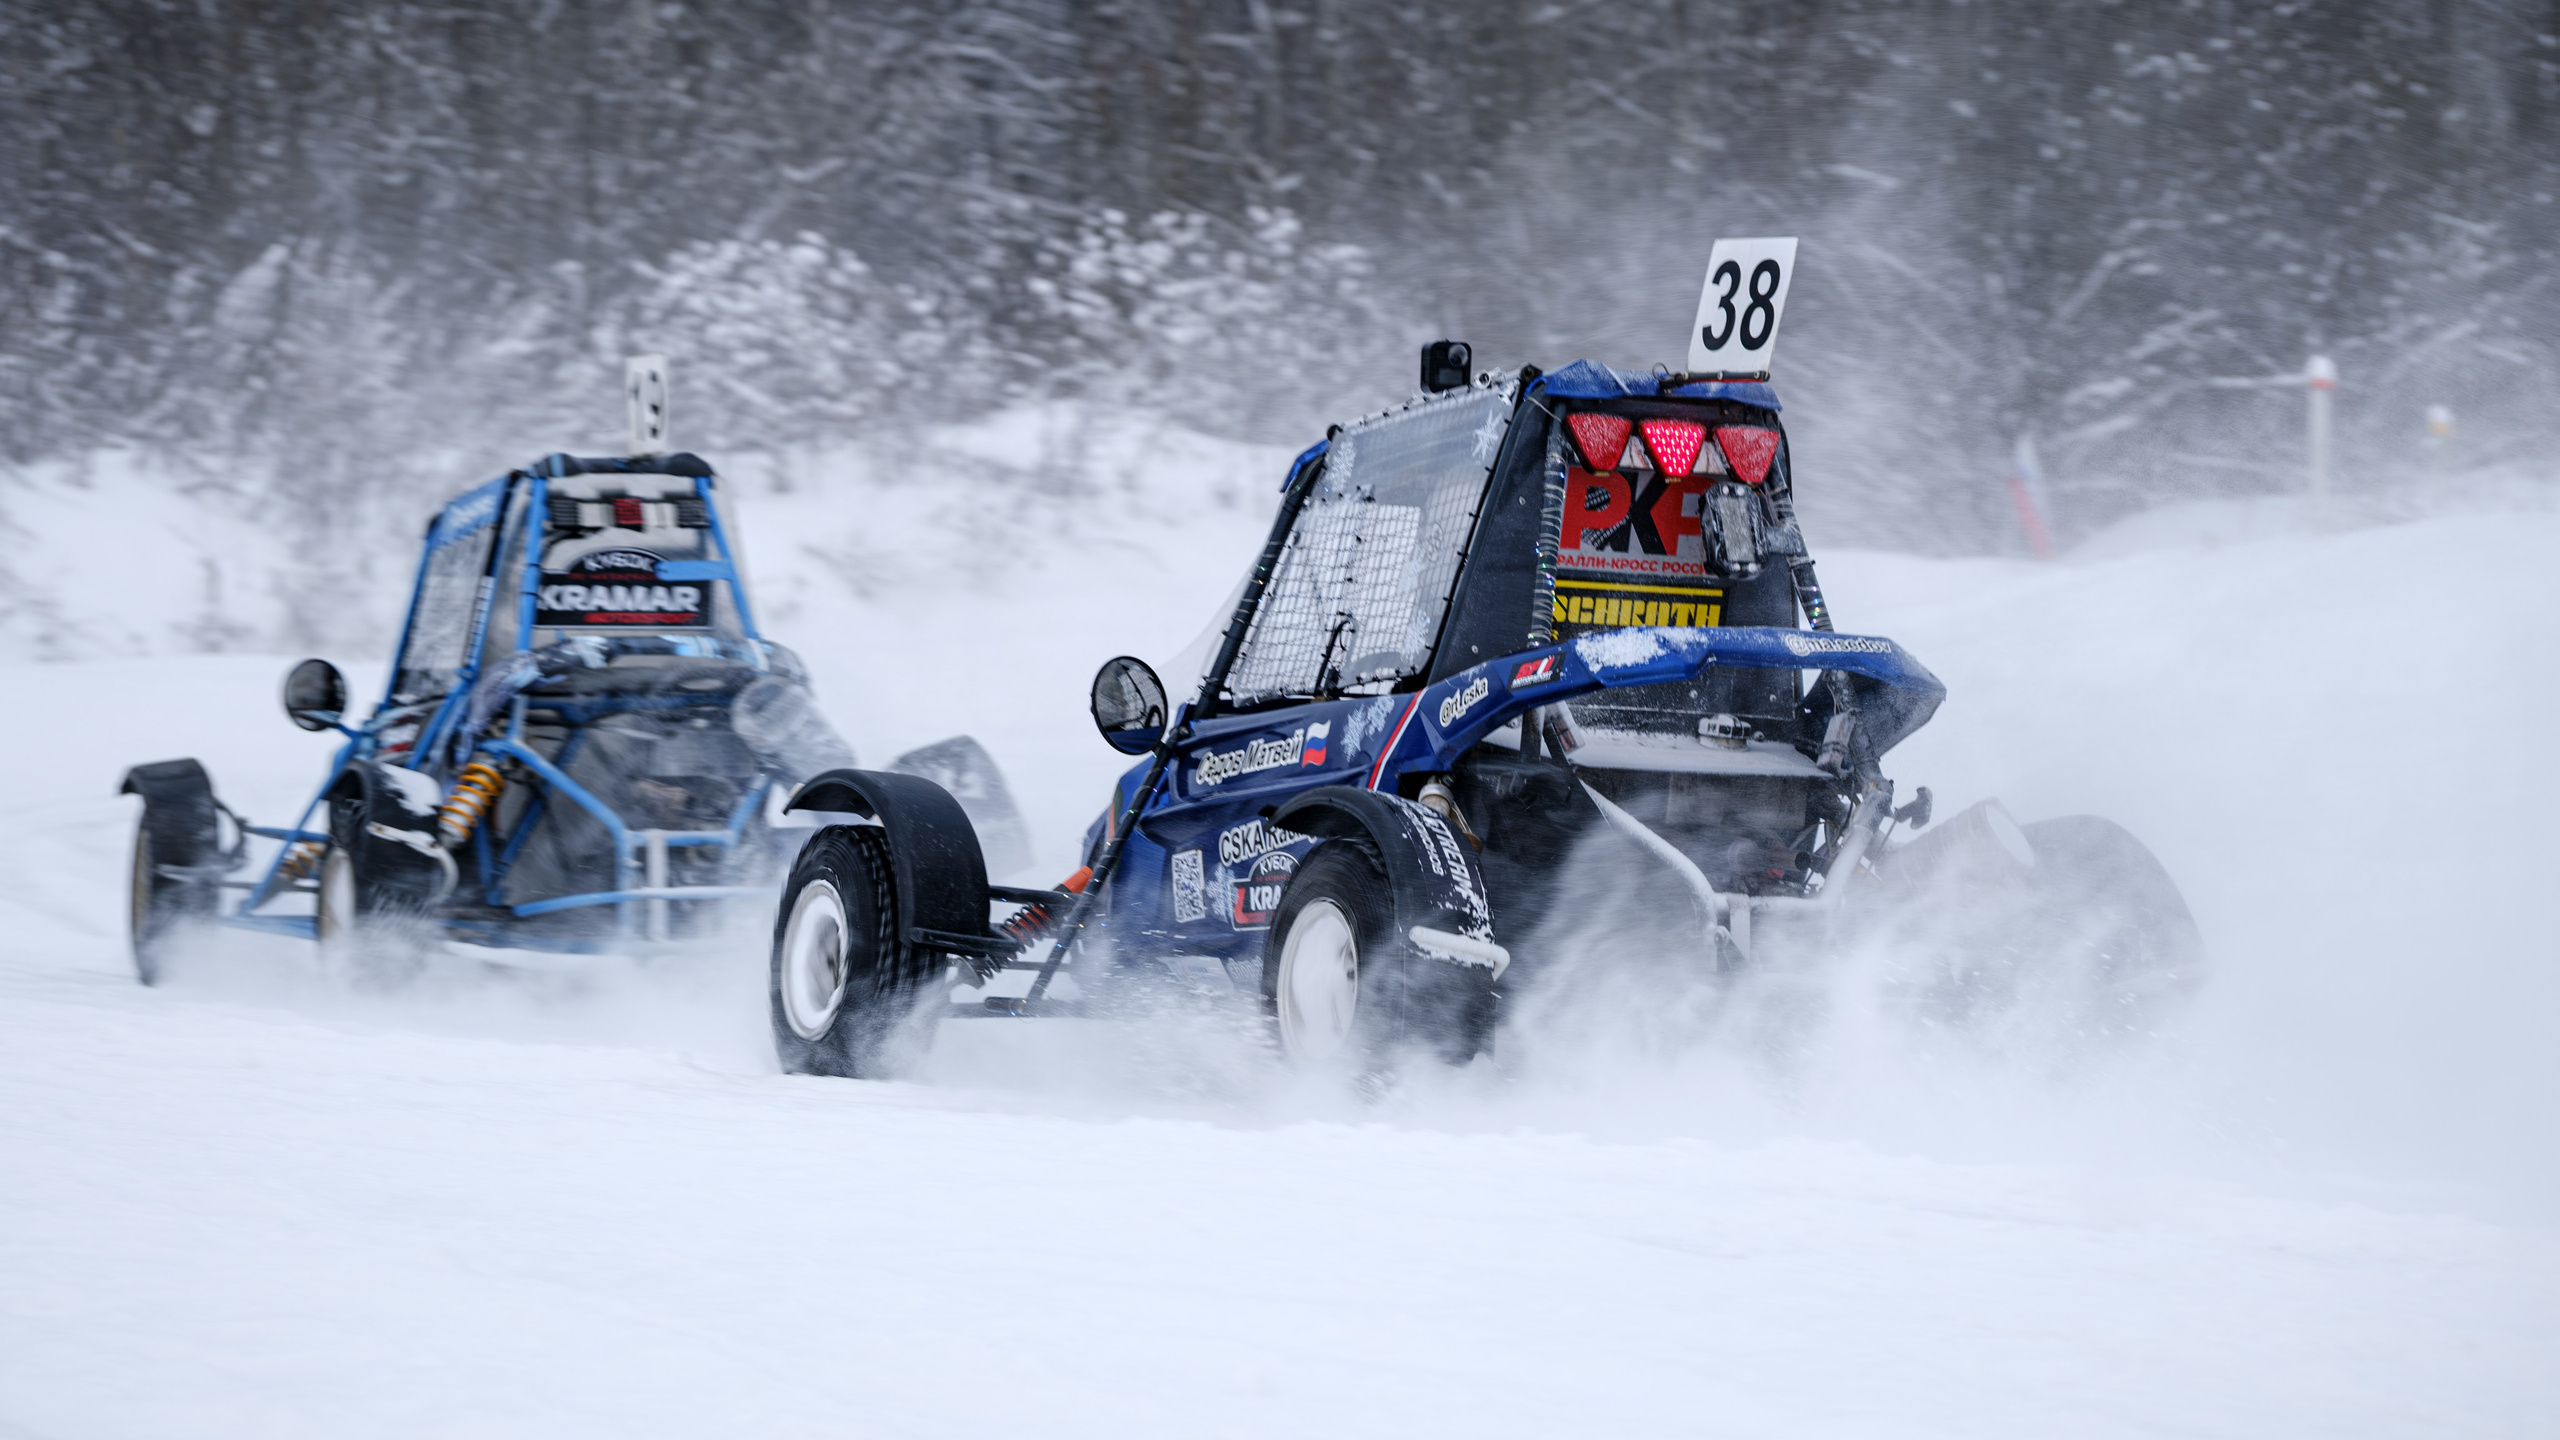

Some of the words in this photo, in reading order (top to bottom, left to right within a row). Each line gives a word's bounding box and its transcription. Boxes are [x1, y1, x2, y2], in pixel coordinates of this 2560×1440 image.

[1702, 259, 1781, 351] 38
[1556, 553, 1659, 573] РАЛЛИ-КРОСС
[1661, 560, 1707, 576] РОССИ
[1196, 750, 1246, 786] Седов
[1241, 728, 1305, 774] Матвей
[1218, 819, 1267, 868] CSKA
[1249, 884, 1284, 911] KRA
